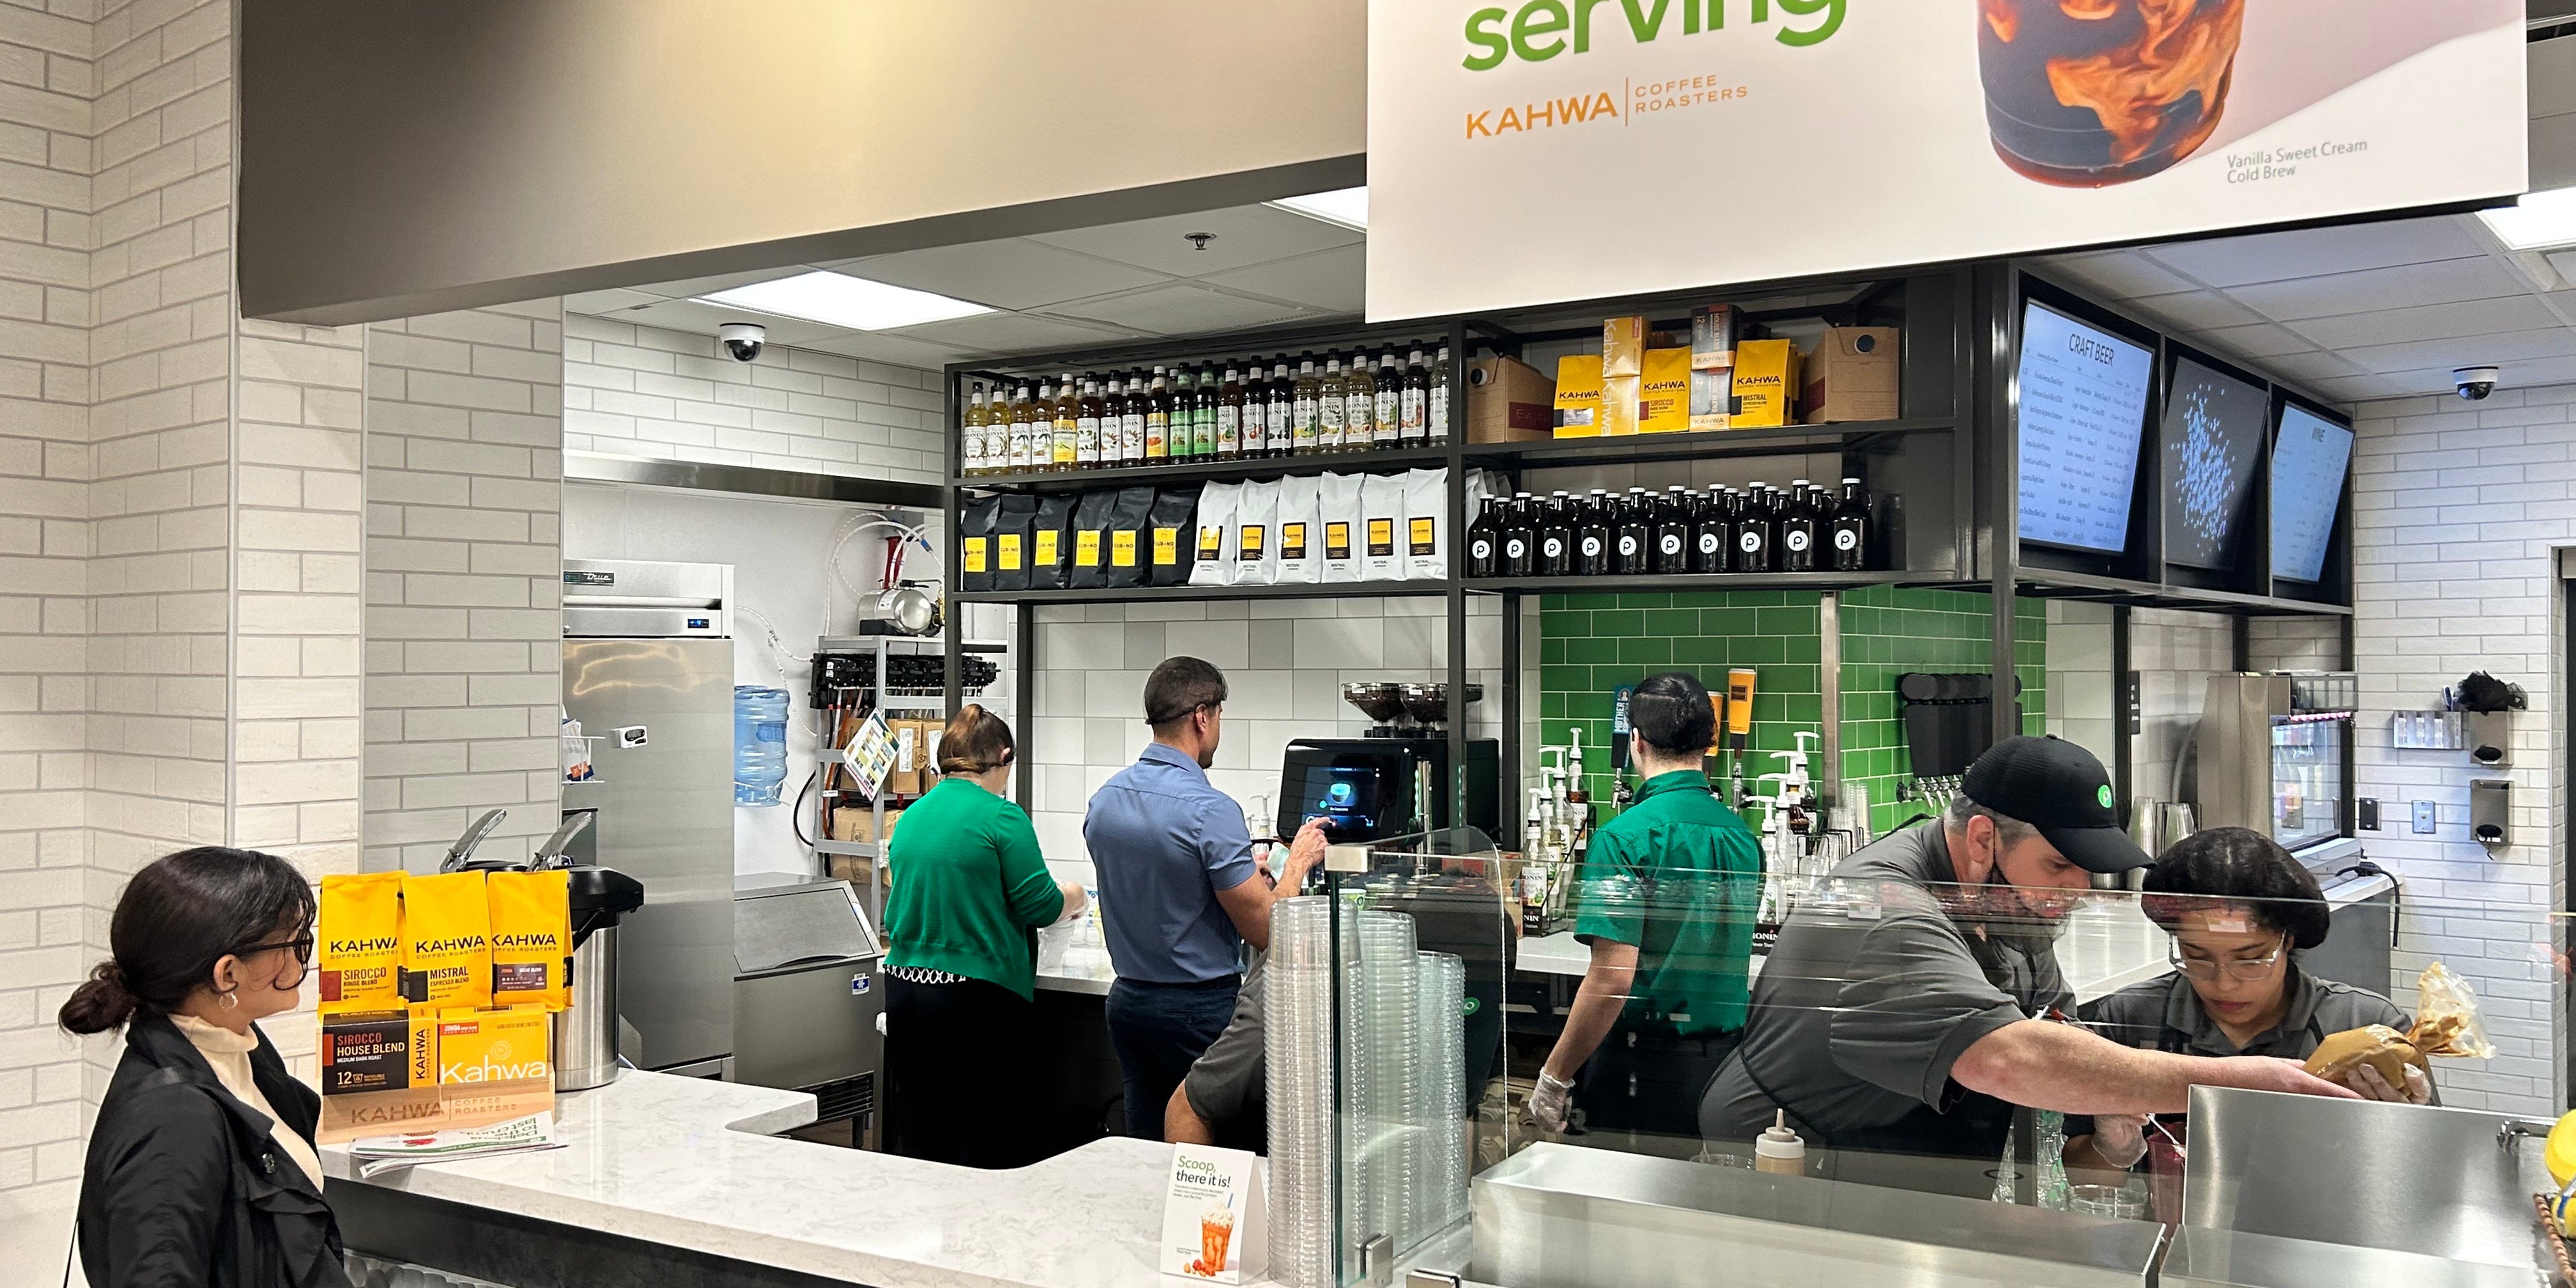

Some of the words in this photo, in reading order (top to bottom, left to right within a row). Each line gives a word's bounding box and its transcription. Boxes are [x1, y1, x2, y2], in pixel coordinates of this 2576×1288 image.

[1635, 74, 1717, 98] COFFEE
[1635, 86, 1749, 114] ROASTERS
[1466, 92, 1618, 139] KAHWA
[2227, 151, 2272, 168] Vanilla
[2276, 146, 2317, 162] Sweet
[2321, 141, 2368, 156] Cream
[2227, 167, 2259, 184] Cold
[2264, 165, 2296, 180] Brew
[1697, 316, 1705, 324] 12
[1603, 319, 1619, 376] Kahwa
[2069, 333, 2095, 358] CRAFT
[2095, 343, 2114, 366] BEER
[1696, 355, 1726, 363] KAHWA
[1644, 381, 1685, 391] KAHWA
[1736, 375, 1781, 385] KAHWA
[1559, 390, 1600, 399] KAHWA
[1601, 378, 1618, 437] Kahwa
[1614, 702, 1625, 732] MOTHER
[416, 935, 486, 953] KAHWA
[492, 934, 556, 946] KAHWA
[449, 947, 486, 956] ROASTERS
[344, 967, 387, 980] SIROCCO
[430, 966, 468, 979] MISTRAL
[337, 1032, 382, 1046] SIROCCO
[337, 1045, 371, 1057] HOUSE
[373, 1042, 405, 1054] BLEND
[416, 1029, 425, 1080] KAHWA
[441, 1054, 546, 1085] Kahwa
[337, 1071, 351, 1085] 12
[455, 1097, 501, 1106] COFFEE
[456, 1103, 517, 1115] ROASTERS
[351, 1101, 445, 1124] KAHWA
[511, 1117, 536, 1130] last
[1178, 1155, 1216, 1174] Scoop,
[1176, 1169, 1206, 1184] there
[1208, 1173, 1217, 1186] it
[1218, 1174, 1231, 1188] is!
